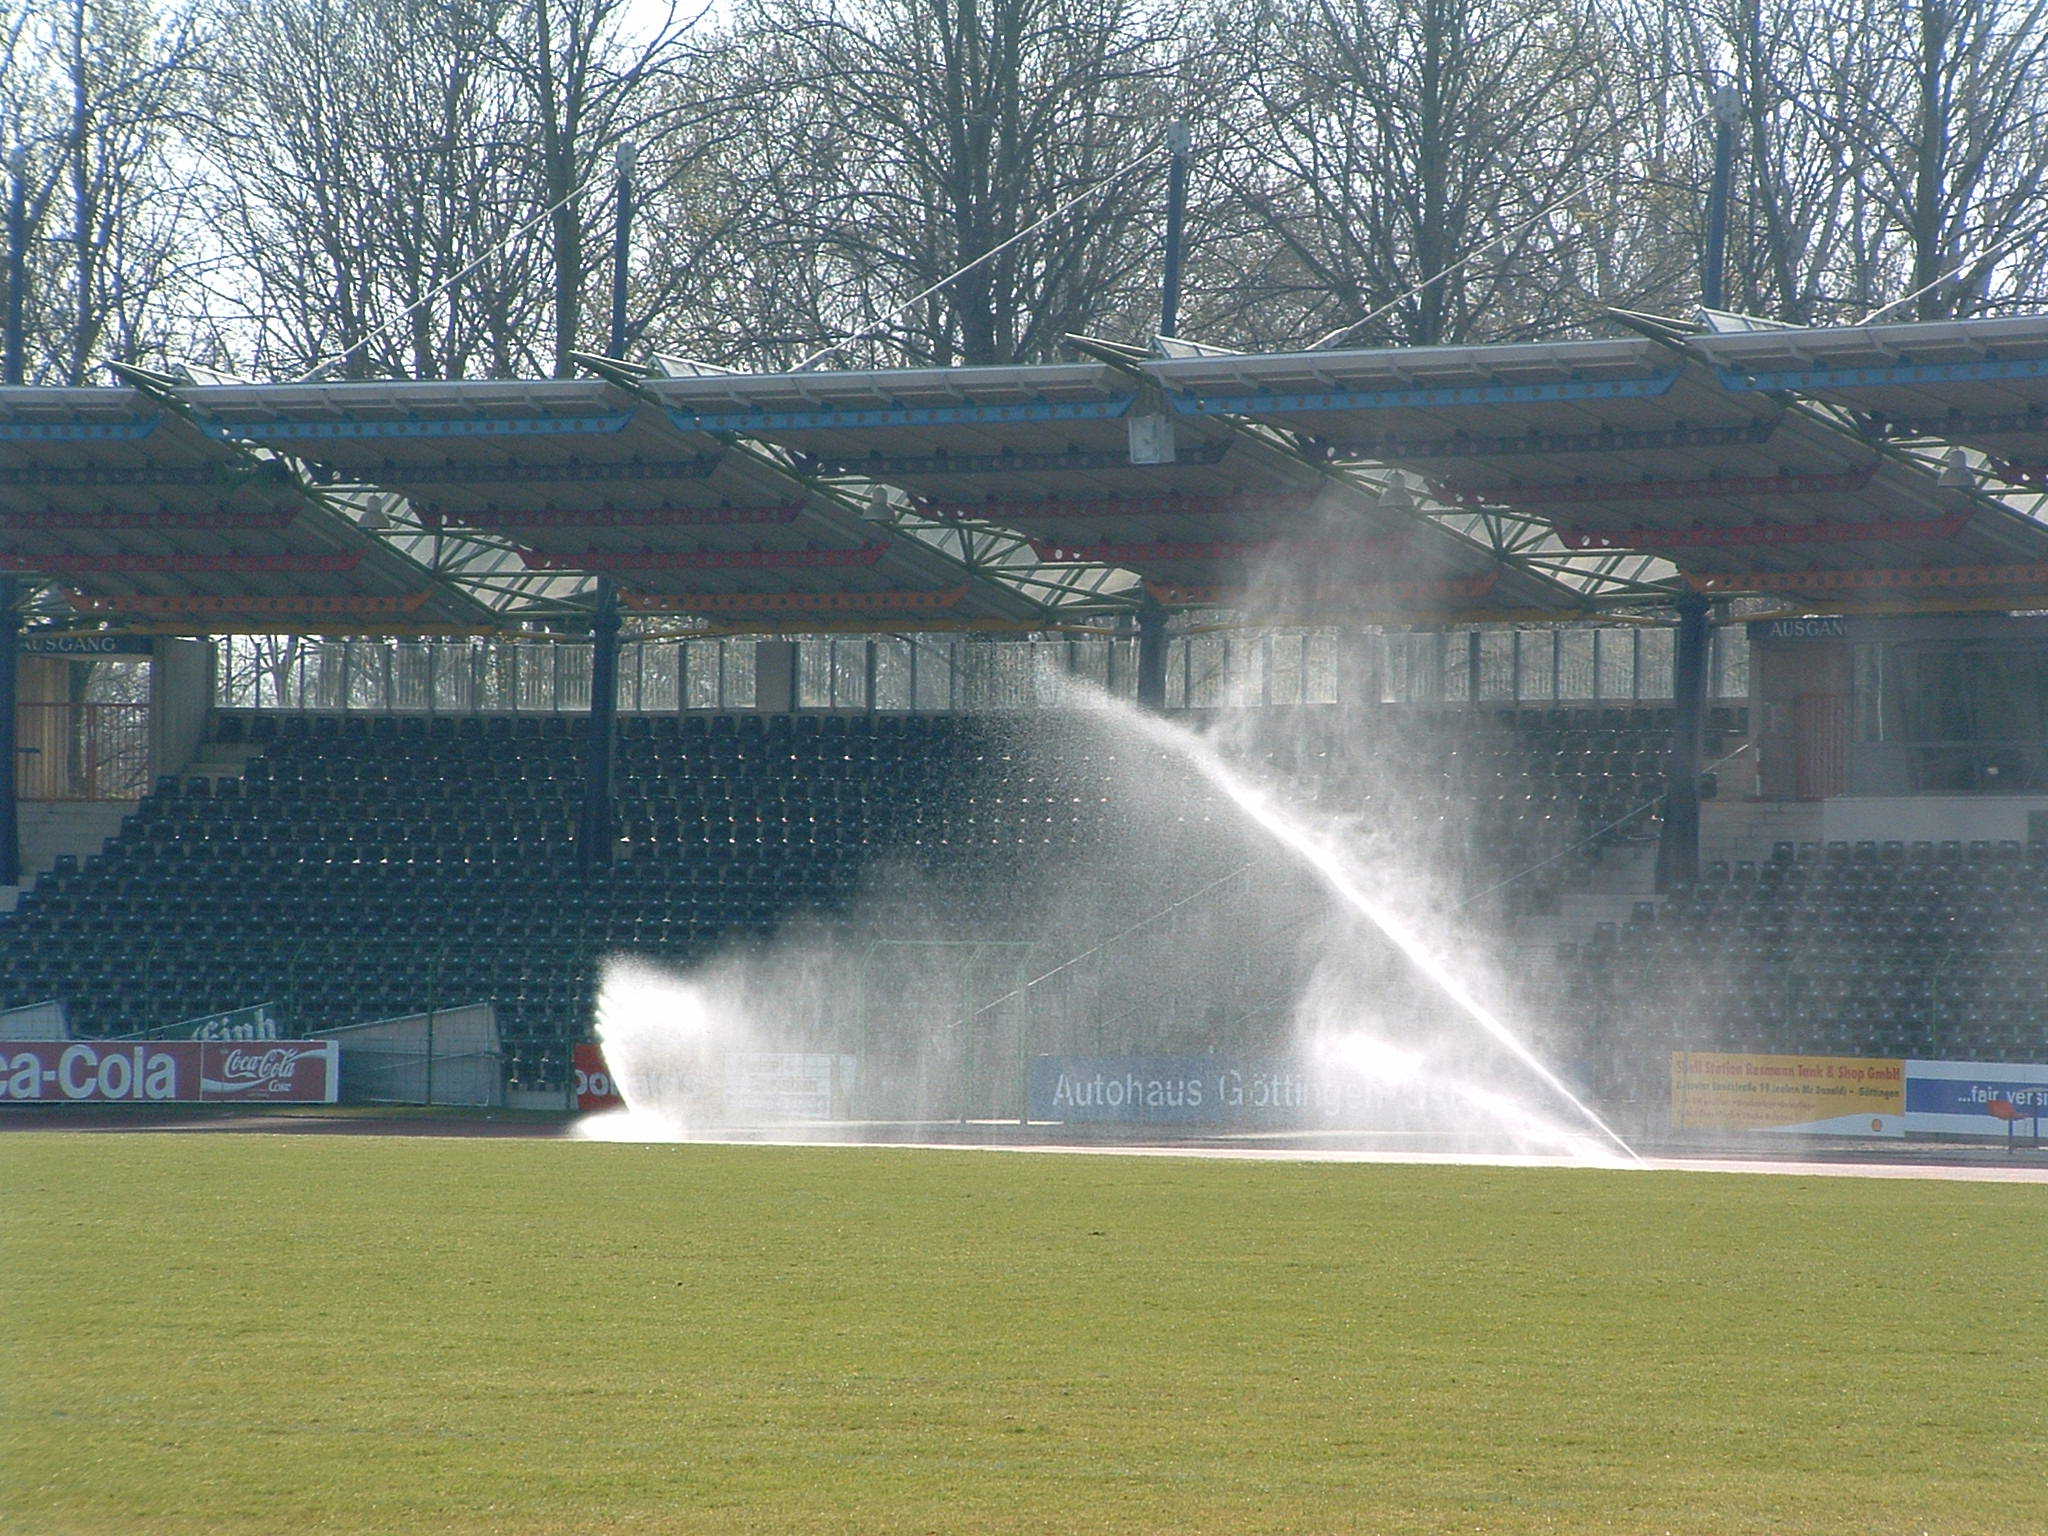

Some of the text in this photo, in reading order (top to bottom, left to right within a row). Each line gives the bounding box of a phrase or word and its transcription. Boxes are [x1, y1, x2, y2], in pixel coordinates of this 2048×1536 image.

[21, 636, 116, 653] AUSGANG
[0, 1043, 176, 1100] a-Cola
[1704, 1060, 1743, 1076] Station
[1797, 1064, 1824, 1078] Tank
[1826, 1065, 1835, 1079] &
[1838, 1065, 1866, 1082] Shop
[1867, 1067, 1901, 1081] GmbH
[1051, 1073, 1203, 1107] Autohaus
